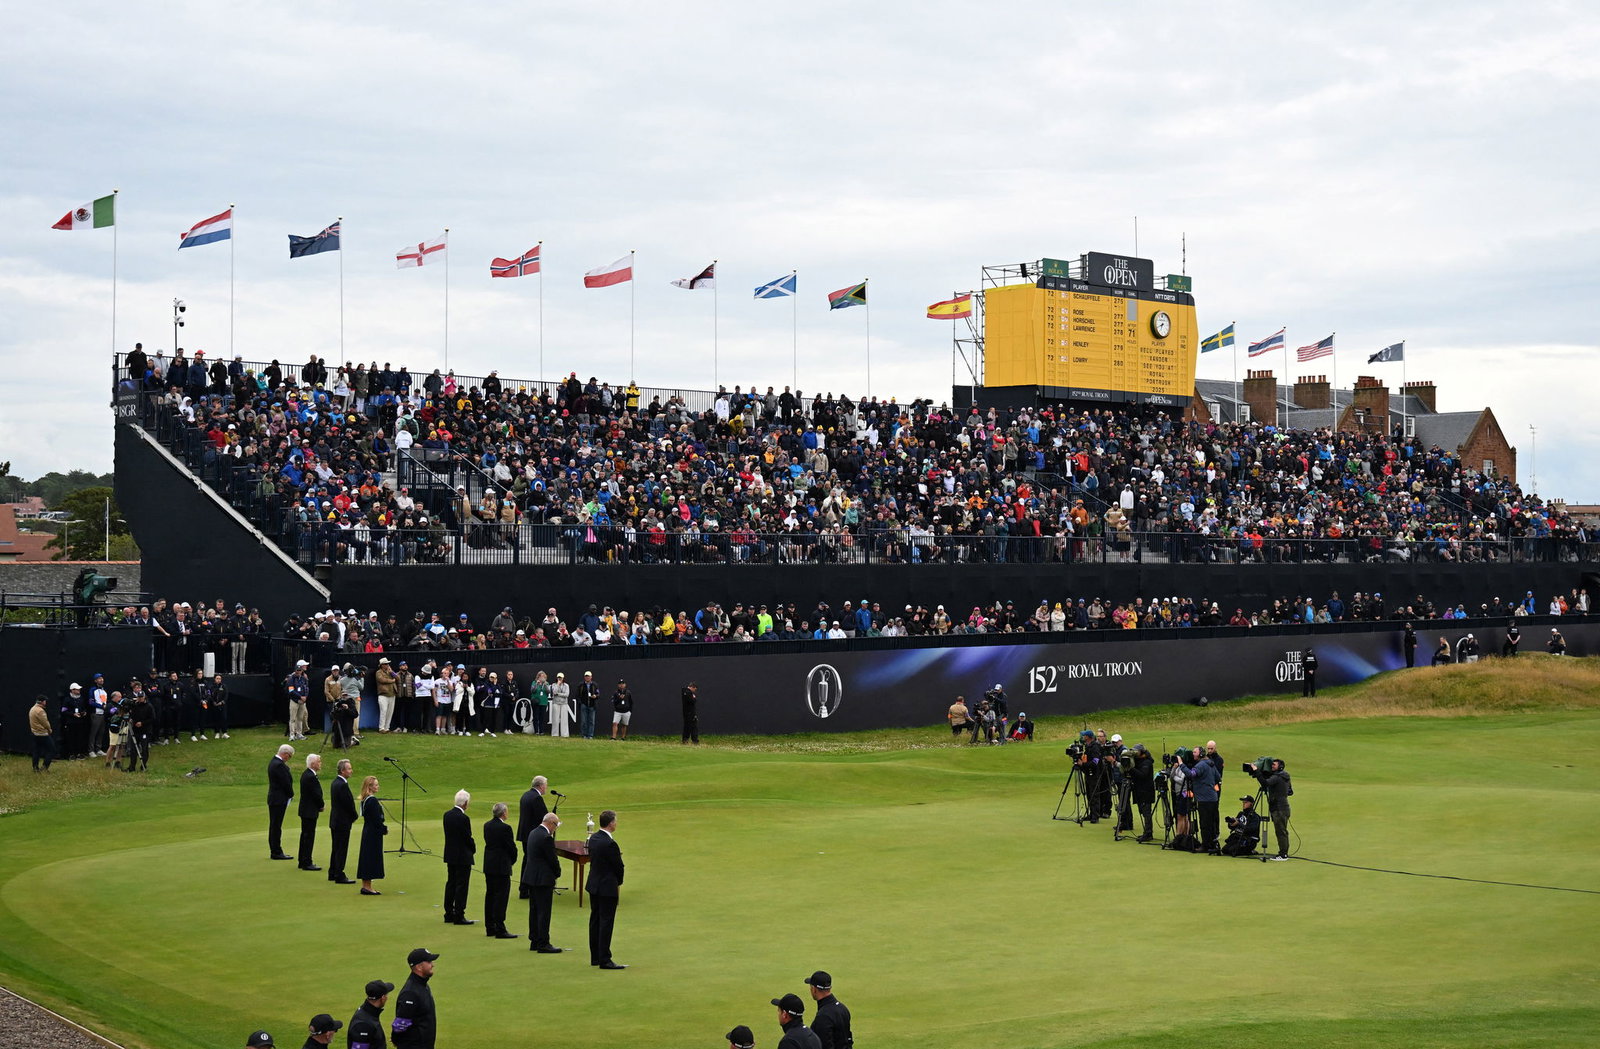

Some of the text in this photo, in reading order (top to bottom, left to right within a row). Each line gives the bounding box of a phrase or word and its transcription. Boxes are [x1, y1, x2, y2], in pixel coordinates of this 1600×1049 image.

[1114, 258, 1128, 270] THE
[1104, 265, 1138, 286] OPEN
[1073, 293, 1100, 301] SCHAUFFELE
[1128, 329, 1135, 337] 71
[1286, 651, 1302, 662] THE
[1068, 664, 1103, 679] ROYAL
[1104, 661, 1142, 677] TROON
